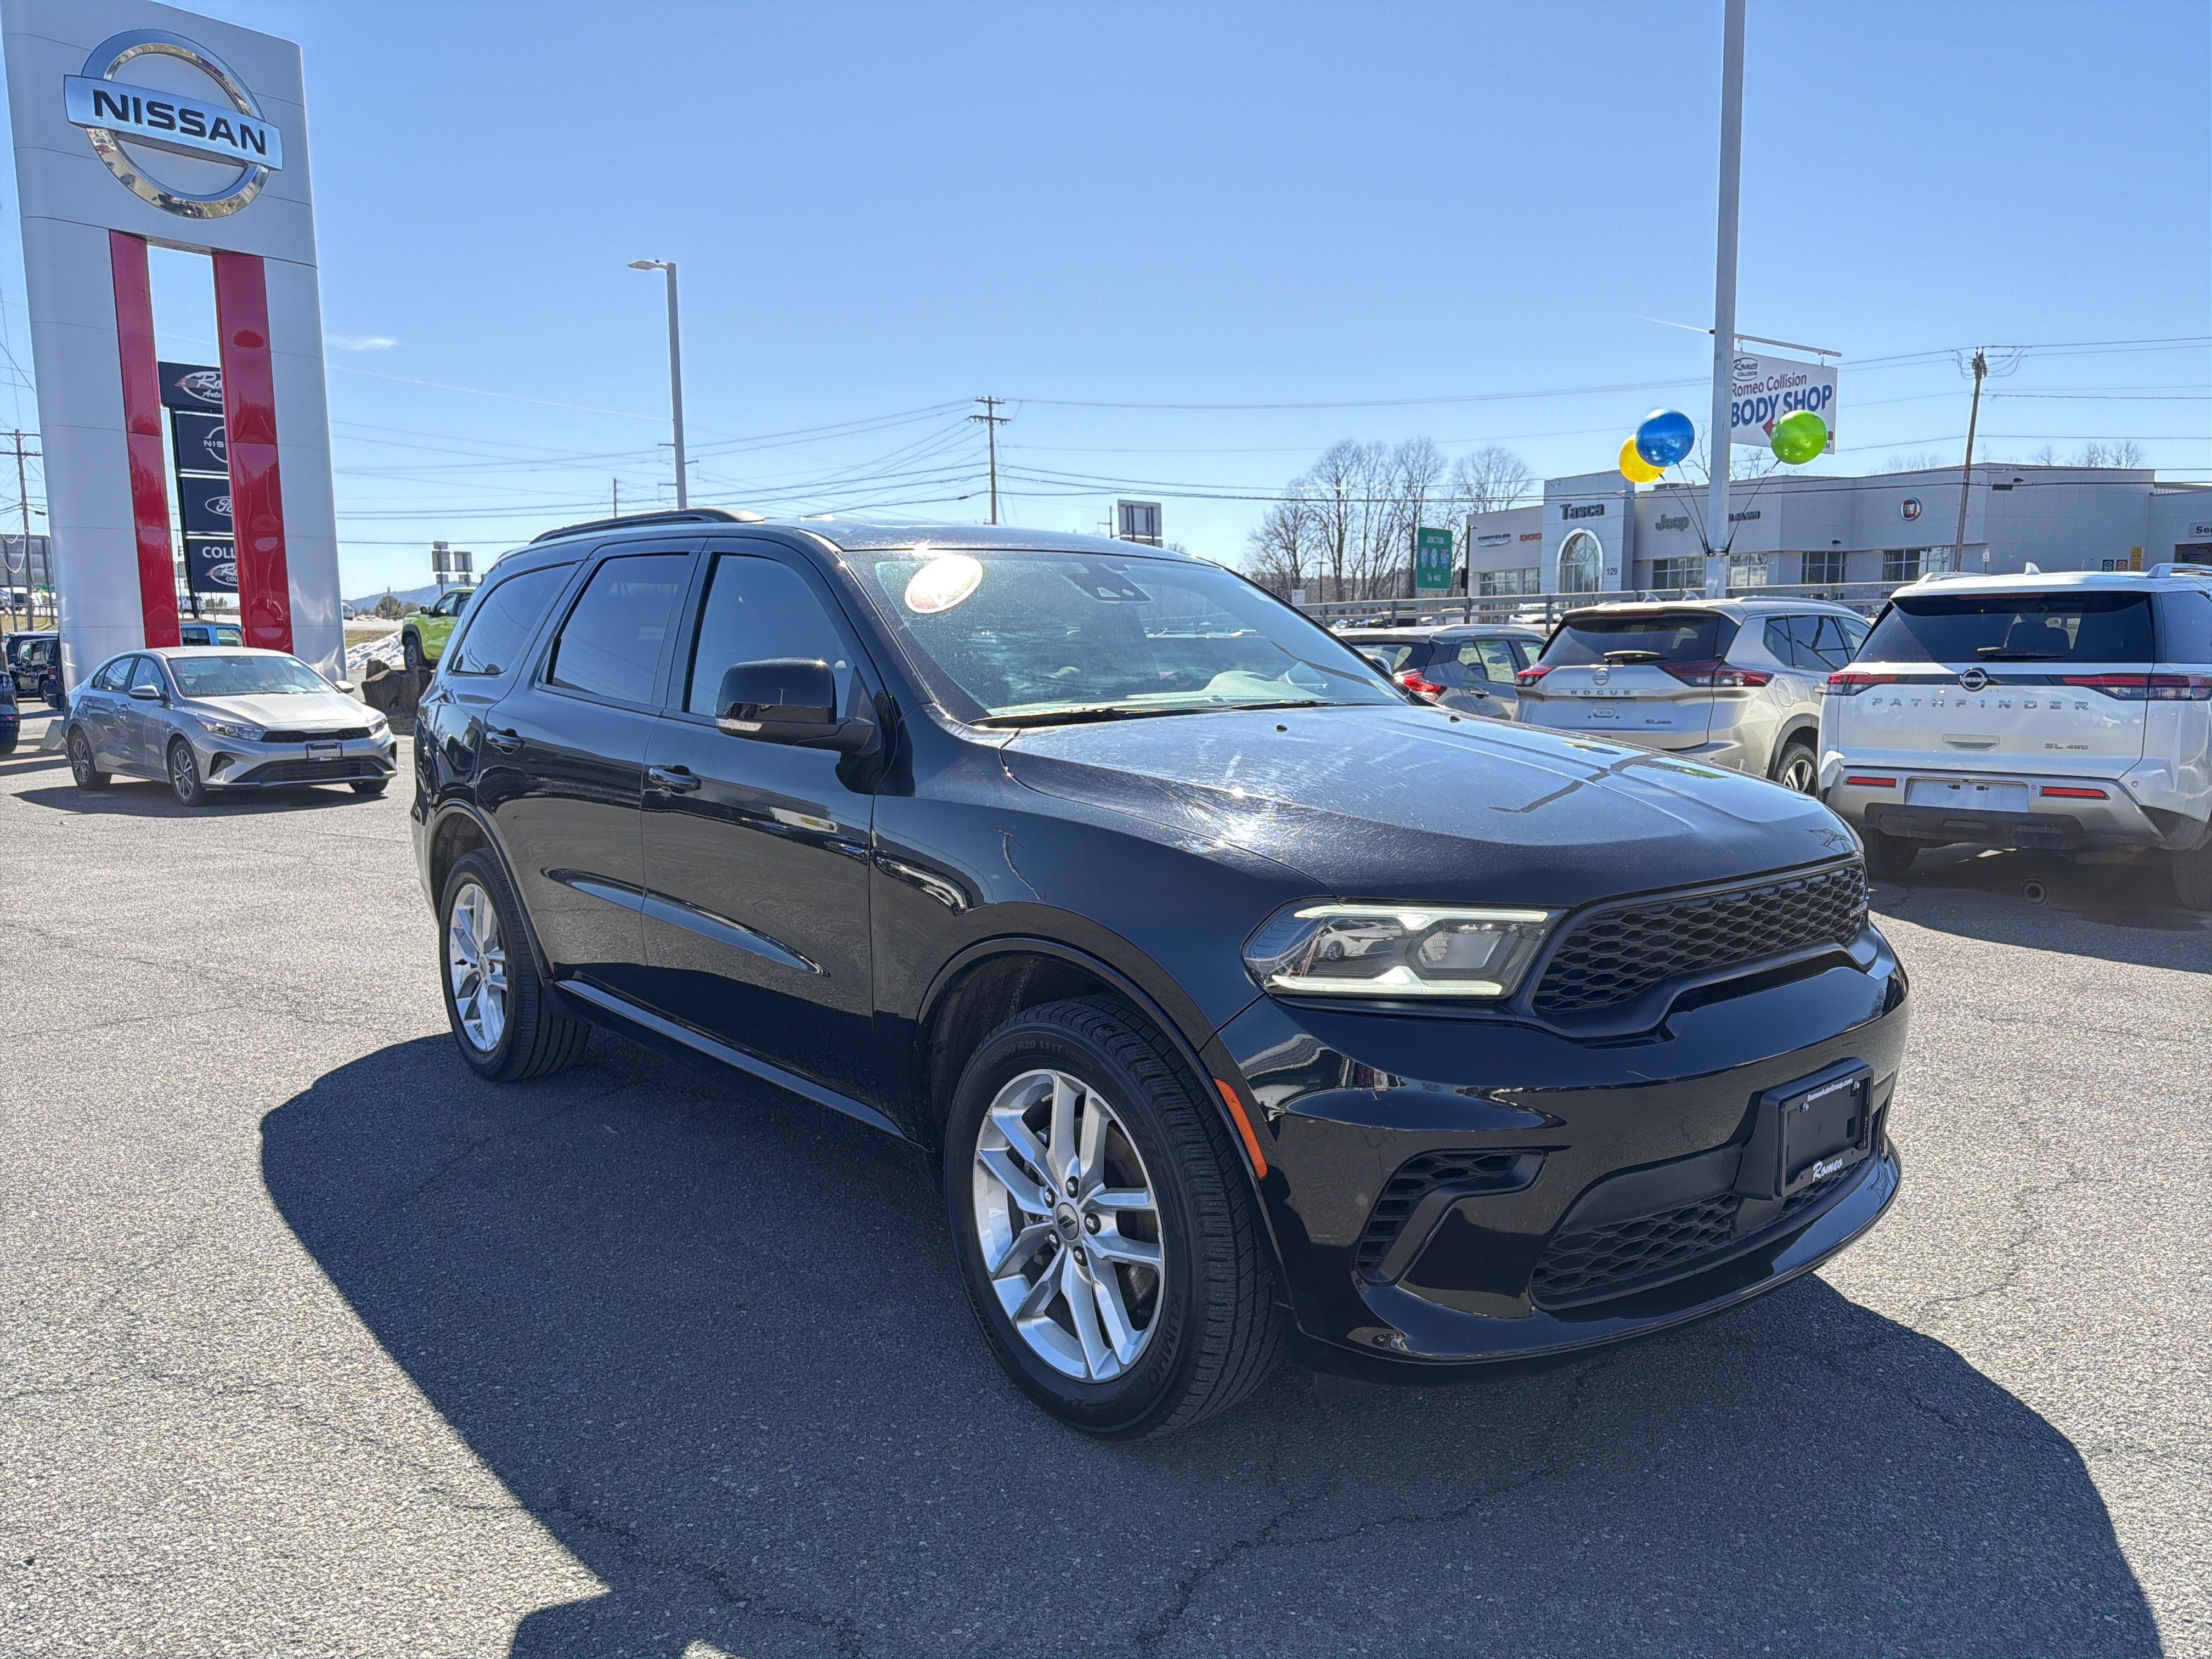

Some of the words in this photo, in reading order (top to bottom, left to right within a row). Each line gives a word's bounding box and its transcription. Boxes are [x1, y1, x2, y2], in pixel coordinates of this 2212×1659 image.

[93, 89, 266, 155] NISSAN
[1733, 382, 1764, 397] Romeo
[1767, 372, 1807, 391] Collision
[1731, 394, 1780, 427] BODY
[1783, 385, 1832, 412] SHOP
[1560, 504, 1605, 520] Tasca
[1655, 514, 1689, 532] Jeep
[1606, 567, 1618, 575] 129
[1871, 697, 2090, 711] PATHFINDER
[1812, 1158, 1844, 1182] Romeo
